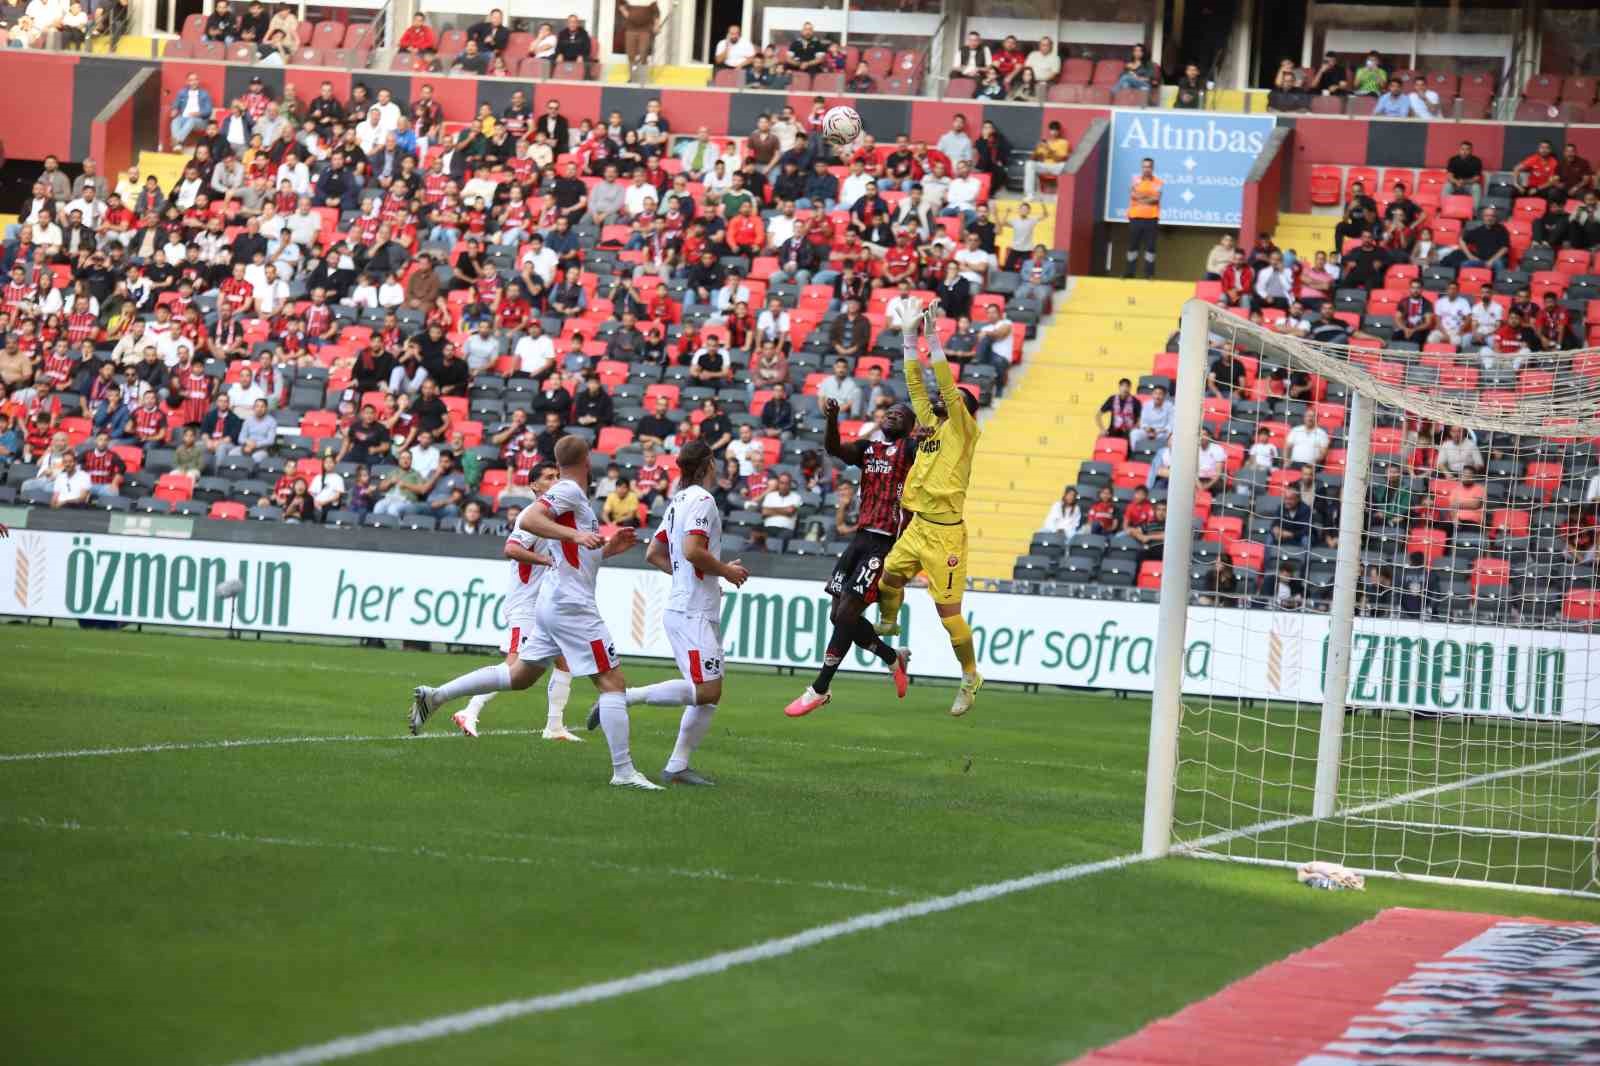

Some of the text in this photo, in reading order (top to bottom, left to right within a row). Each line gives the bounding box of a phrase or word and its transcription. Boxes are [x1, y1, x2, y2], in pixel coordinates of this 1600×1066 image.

[236, 560, 292, 626] un
[332, 569, 509, 641] her sofr
[857, 566, 876, 587] 14
[946, 571, 953, 589] 1
[967, 611, 1212, 686] her sofraa
[1320, 620, 1567, 716] zmen un
